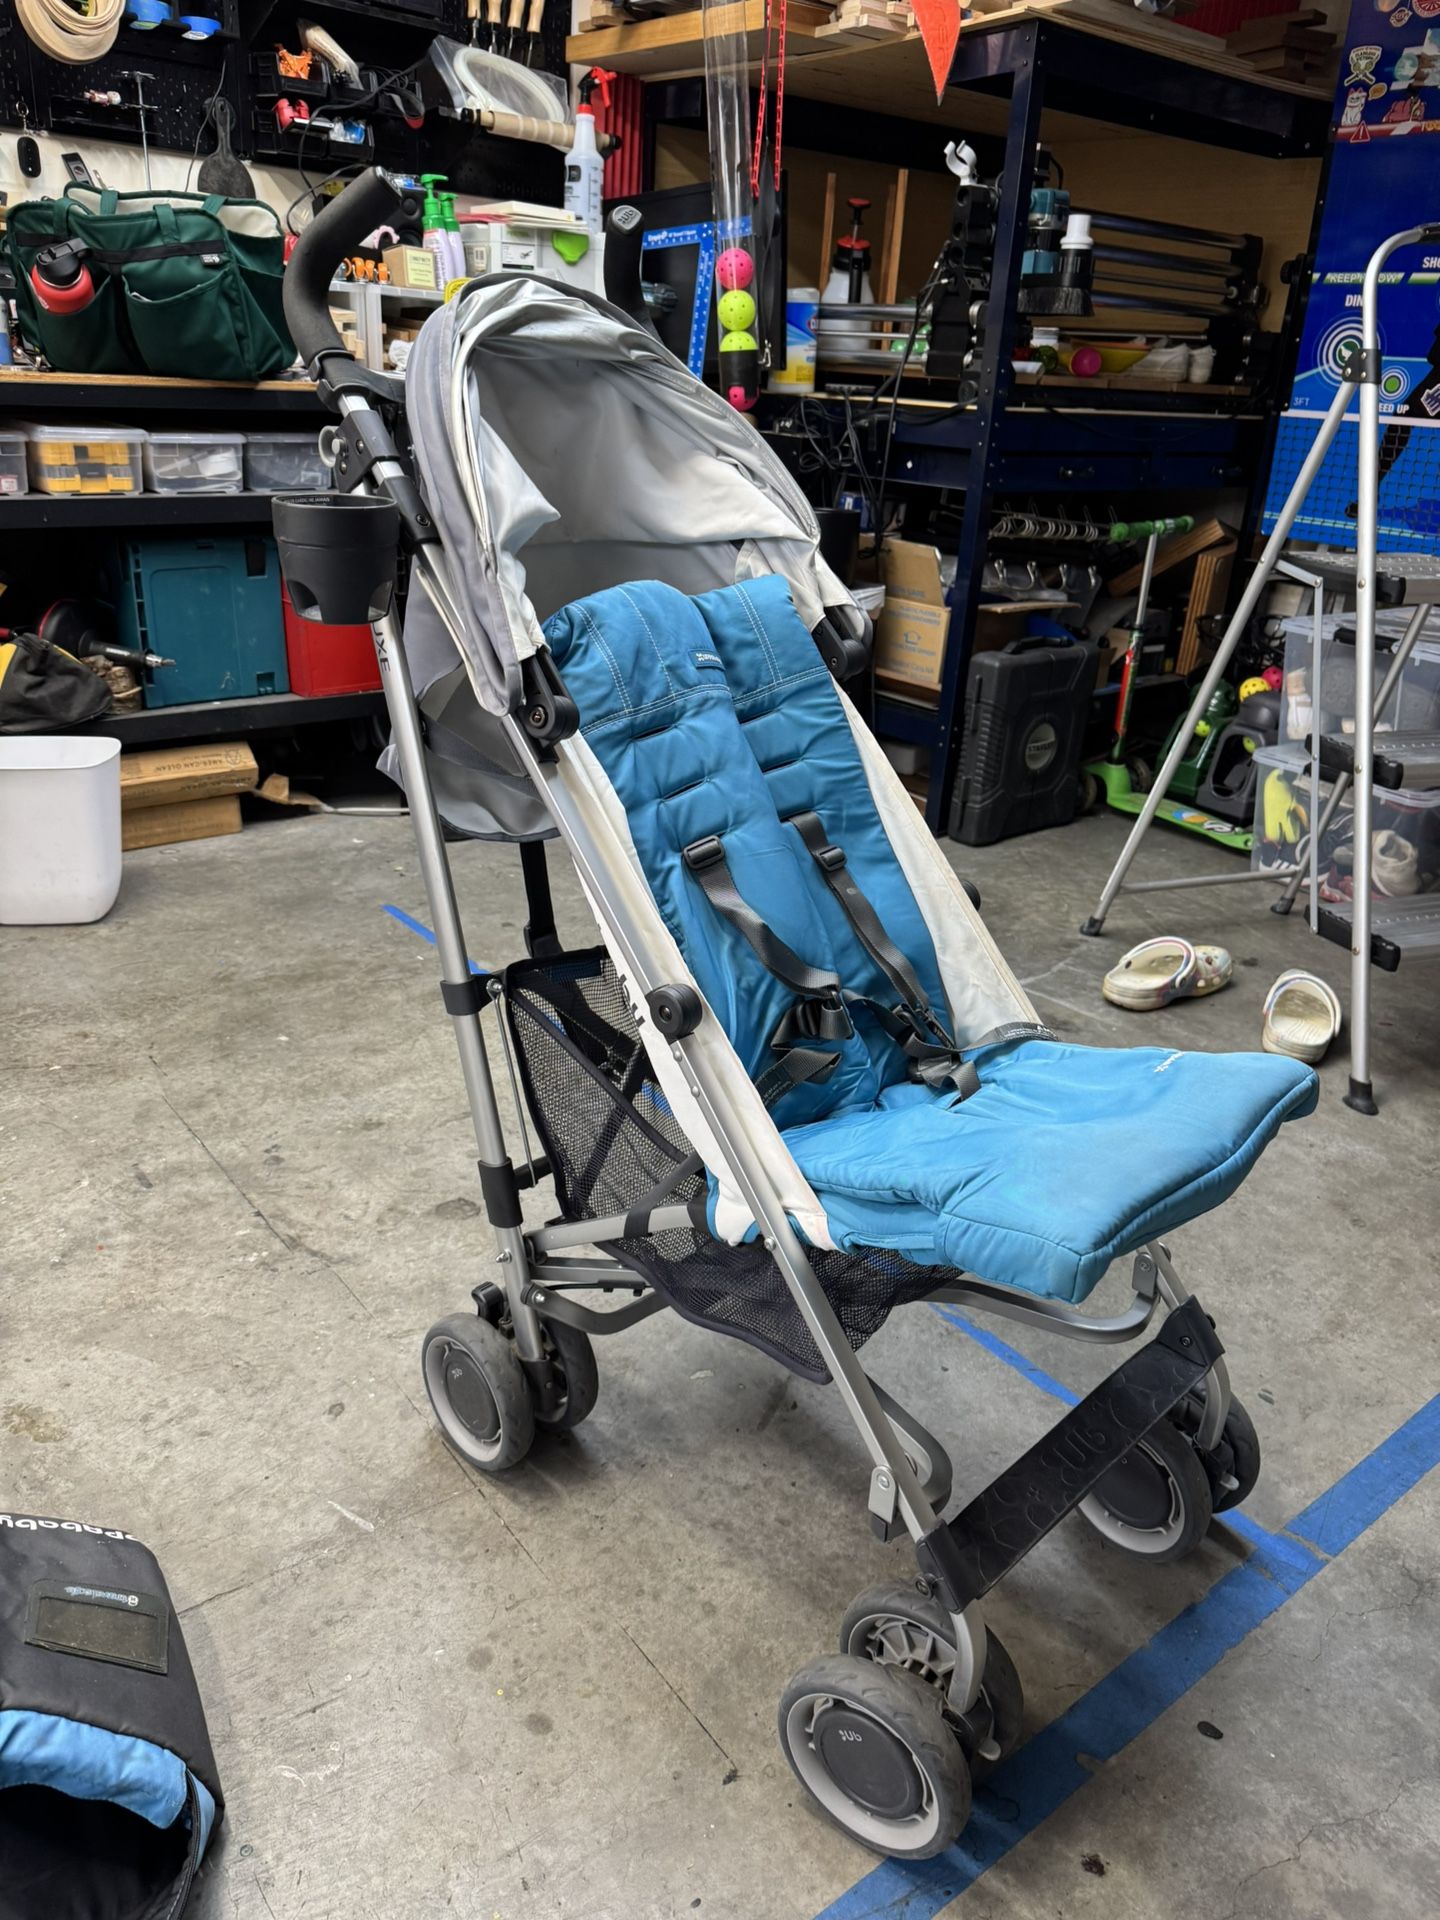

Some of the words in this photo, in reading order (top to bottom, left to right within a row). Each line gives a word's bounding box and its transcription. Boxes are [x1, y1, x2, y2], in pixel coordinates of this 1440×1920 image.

[1377, 273, 1397, 283] OW
[1345, 294, 1364, 307] DIN
[1396, 404, 1410, 414] UP
